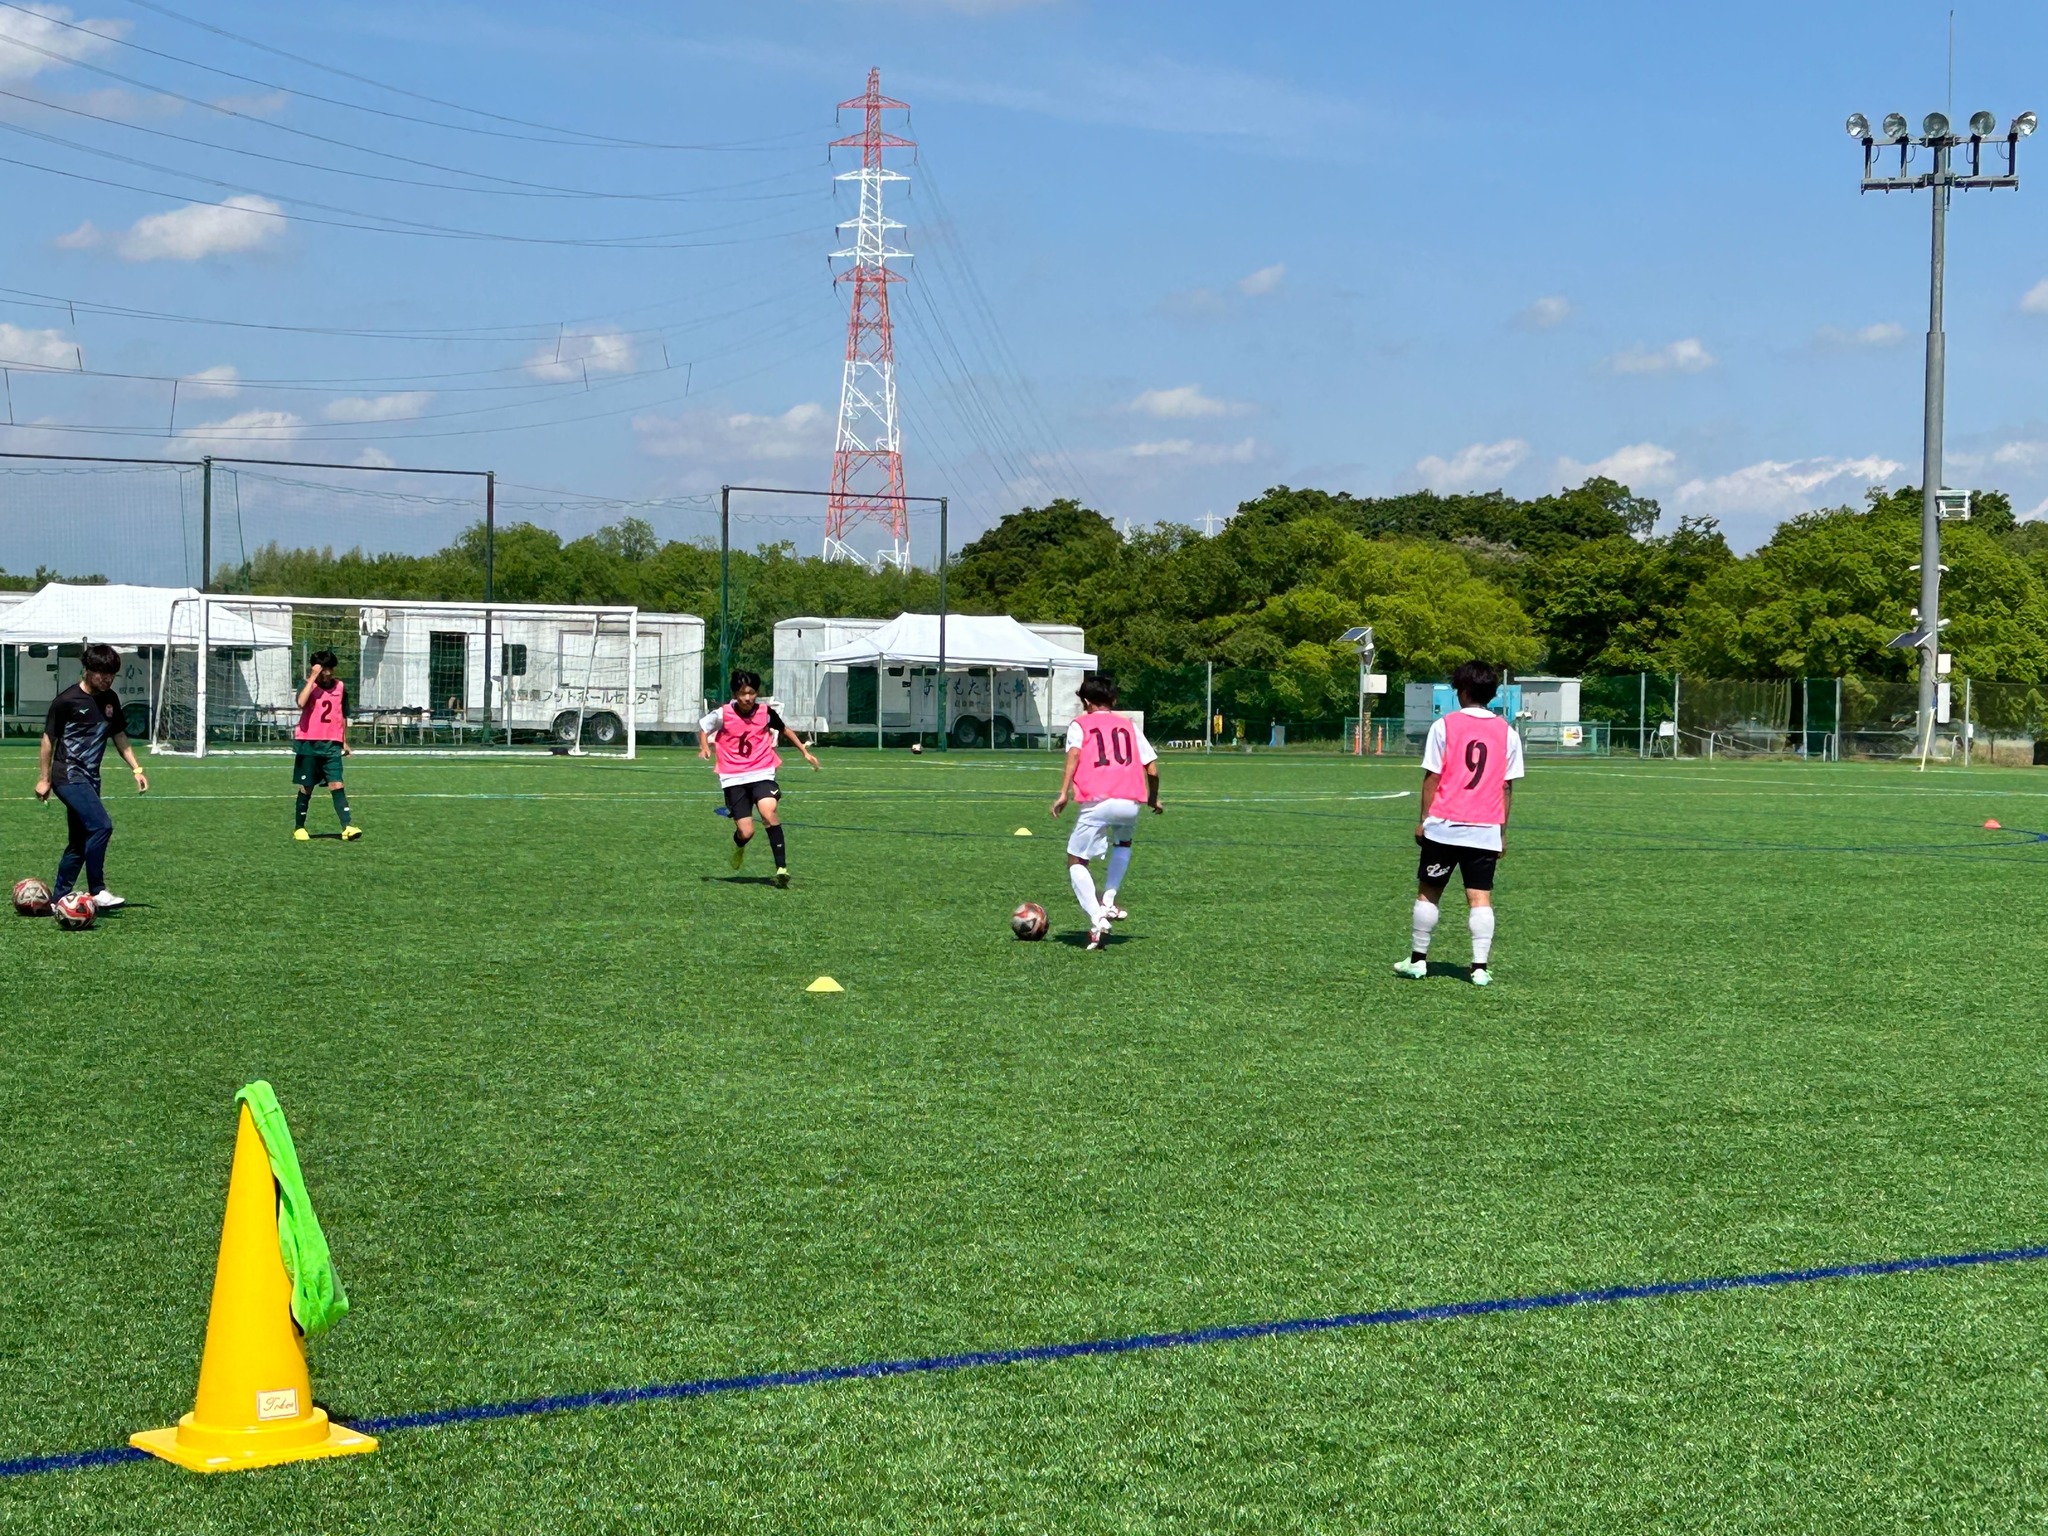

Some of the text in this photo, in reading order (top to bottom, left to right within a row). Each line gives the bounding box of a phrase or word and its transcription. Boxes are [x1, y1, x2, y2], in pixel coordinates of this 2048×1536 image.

[321, 699, 333, 724] 2
[738, 730, 753, 759] 6
[1089, 727, 1133, 768] 10
[1463, 739, 1488, 791] 9
